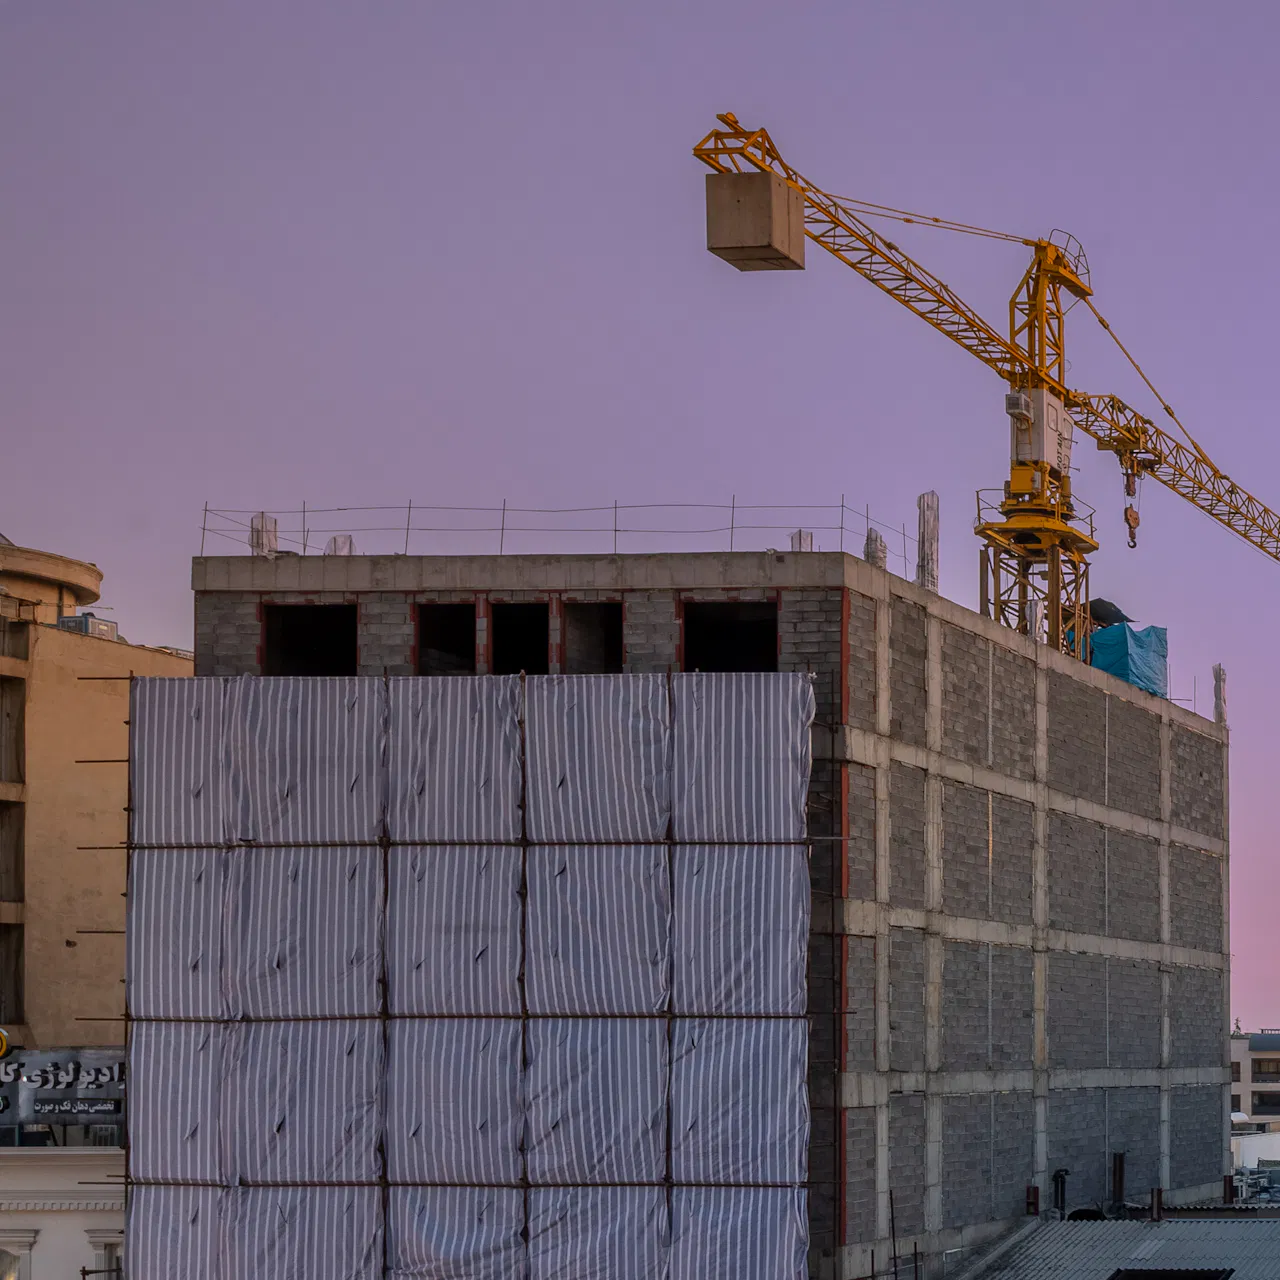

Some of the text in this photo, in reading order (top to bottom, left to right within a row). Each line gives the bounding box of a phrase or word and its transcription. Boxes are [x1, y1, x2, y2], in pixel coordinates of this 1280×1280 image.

[34, 1102, 54, 1113] صورت
[60, 1100, 71, 1110] فک
[72, 1101, 88, 1112] دهان
[89, 1101, 114, 1112] تخصصی
